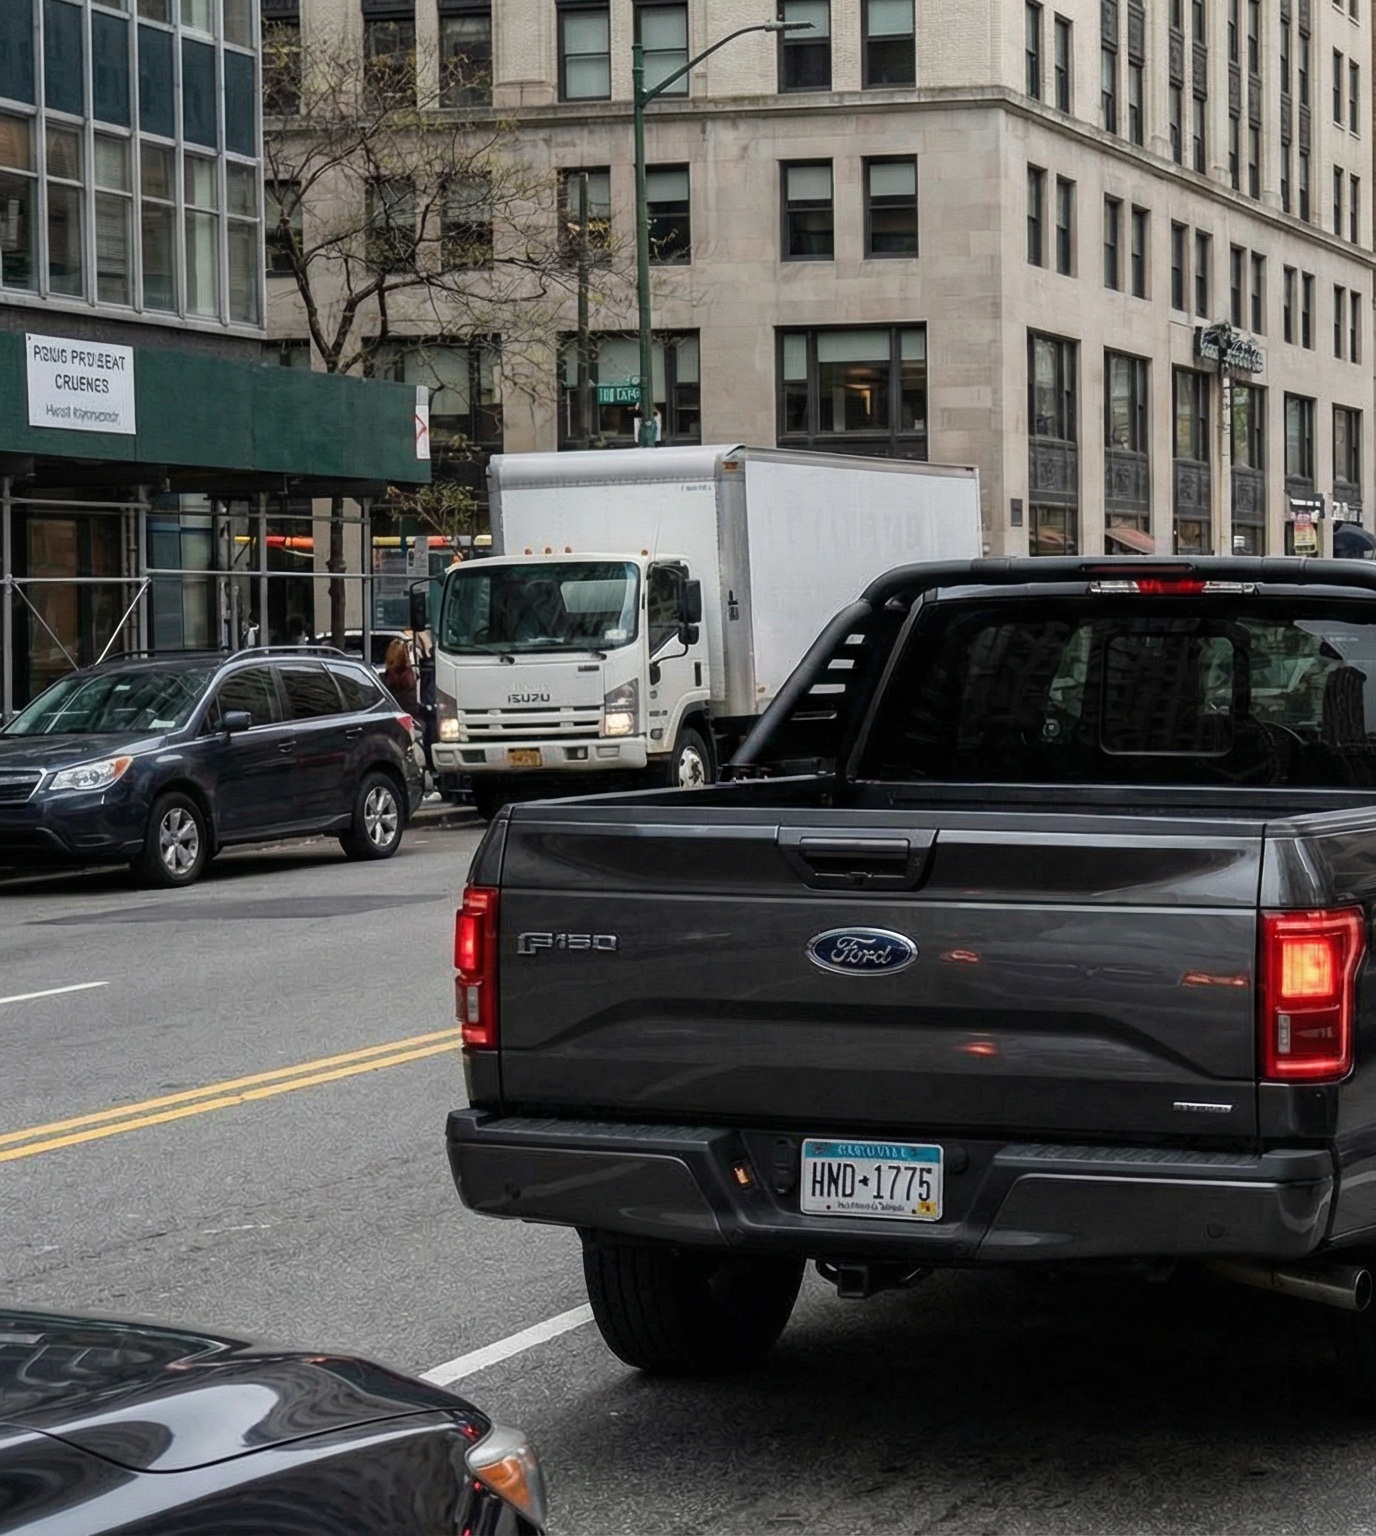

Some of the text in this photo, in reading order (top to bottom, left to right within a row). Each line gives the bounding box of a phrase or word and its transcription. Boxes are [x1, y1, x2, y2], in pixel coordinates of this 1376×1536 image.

[507, 693, 550, 704] ISUZU
[830, 936, 892, 964] Ford
[811, 1161, 933, 1202] HND 1775
